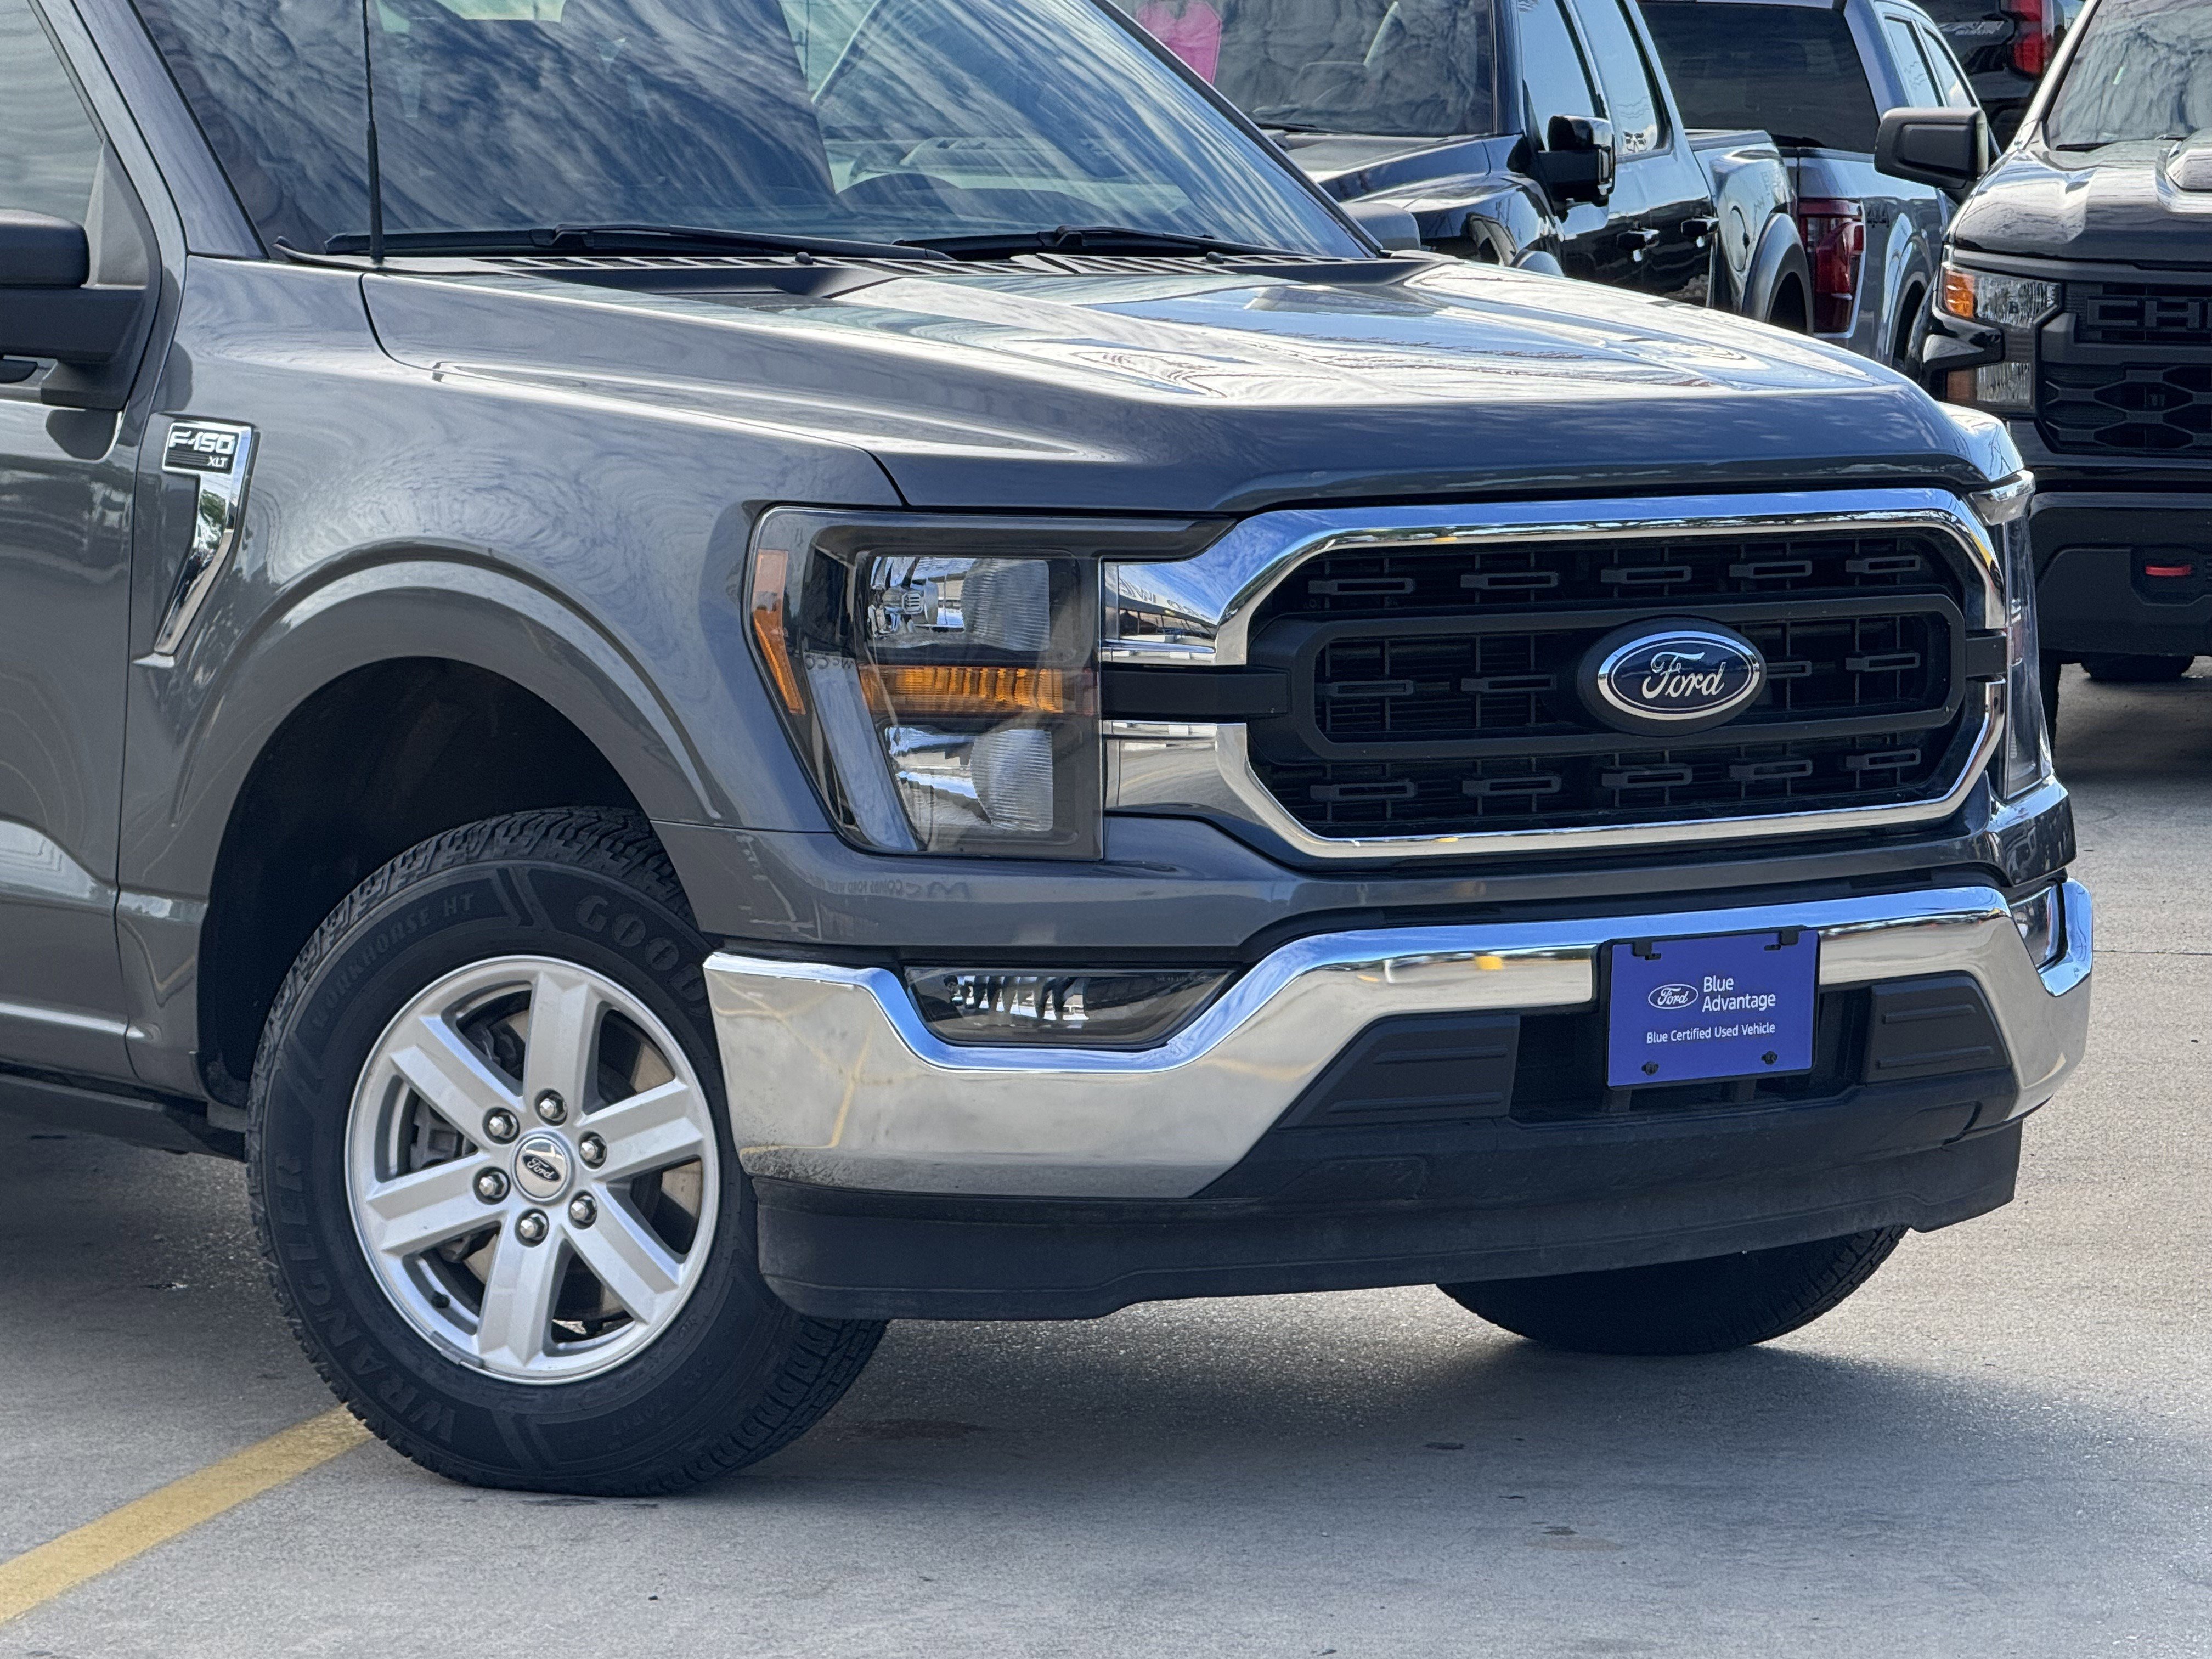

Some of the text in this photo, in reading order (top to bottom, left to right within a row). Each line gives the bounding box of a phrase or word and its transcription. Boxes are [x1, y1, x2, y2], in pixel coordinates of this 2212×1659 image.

[2087, 299, 2212, 328] CH
[168, 431, 235, 455] F-150
[207, 455, 229, 468] XLT
[1641, 651, 1726, 699] Ford
[442, 892, 475, 917] HT
[1703, 975, 1734, 992] Blue
[1657, 988, 1689, 1006] Ford
[1702, 993, 1776, 1013] Advantage
[1646, 1022, 1776, 1044] Blue Certified Used Vehicle
[527, 1157, 555, 1180] Ford
[274, 1150, 457, 1443] WRANGLER
